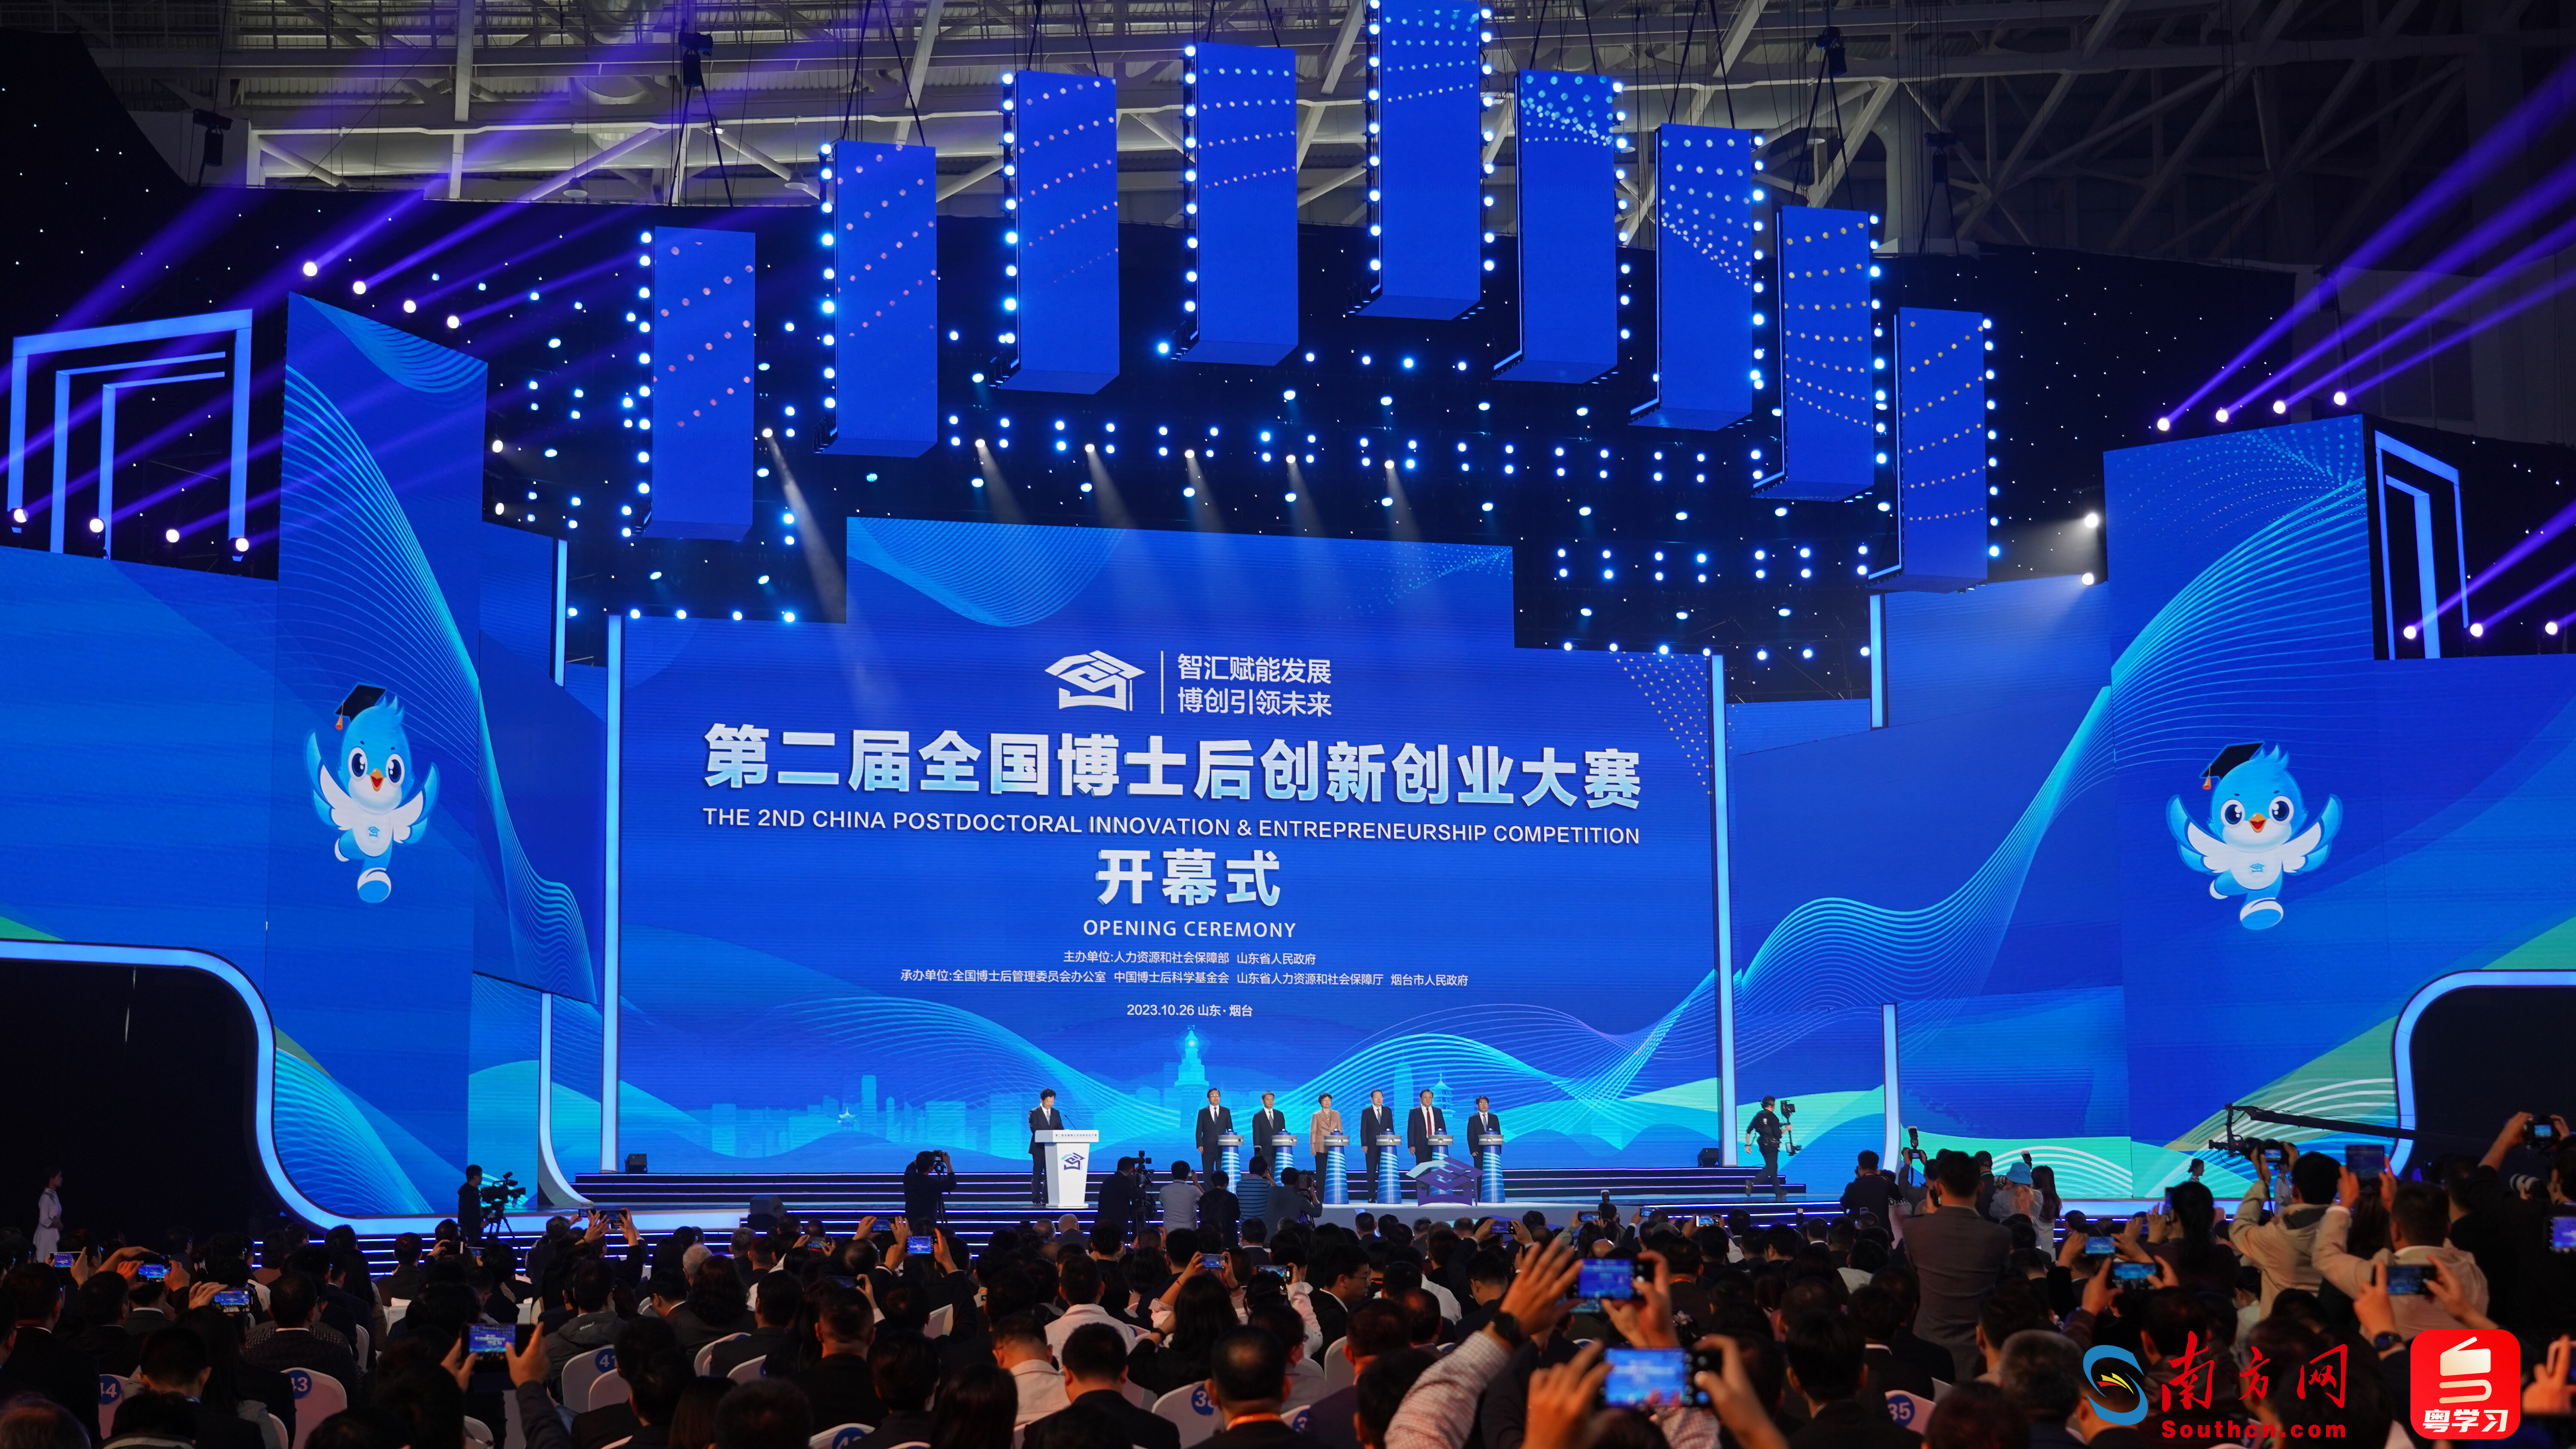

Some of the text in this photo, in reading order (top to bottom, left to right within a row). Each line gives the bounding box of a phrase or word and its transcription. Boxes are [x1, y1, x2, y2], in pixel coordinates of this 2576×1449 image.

[1178, 653, 1331, 684] 智汇赋能发展
[1178, 687, 1332, 717] 博创引领未来
[703, 723, 1641, 809] 第二届全国博士后创新创业大赛
[703, 808, 1640, 844] THE 2ND CHINA POSTDOCTORAL INNOVATION & ENTREPRENEURSHIP COMPETITION
[1096, 848, 1280, 906] 开幕式
[1083, 919, 1296, 937] OPENING CEREMONY
[1063, 950, 1316, 965] 主办单位:人力资源和社会保障部 山东省人民政府
[901, 969, 1468, 986] 承办单位:全国博士后管理委员会办公室 中国博士后科学基金会 山东省人力资源和社会保障厅 烟台市人民政府
[1127, 1004, 1194, 1016] 2023.10.26
